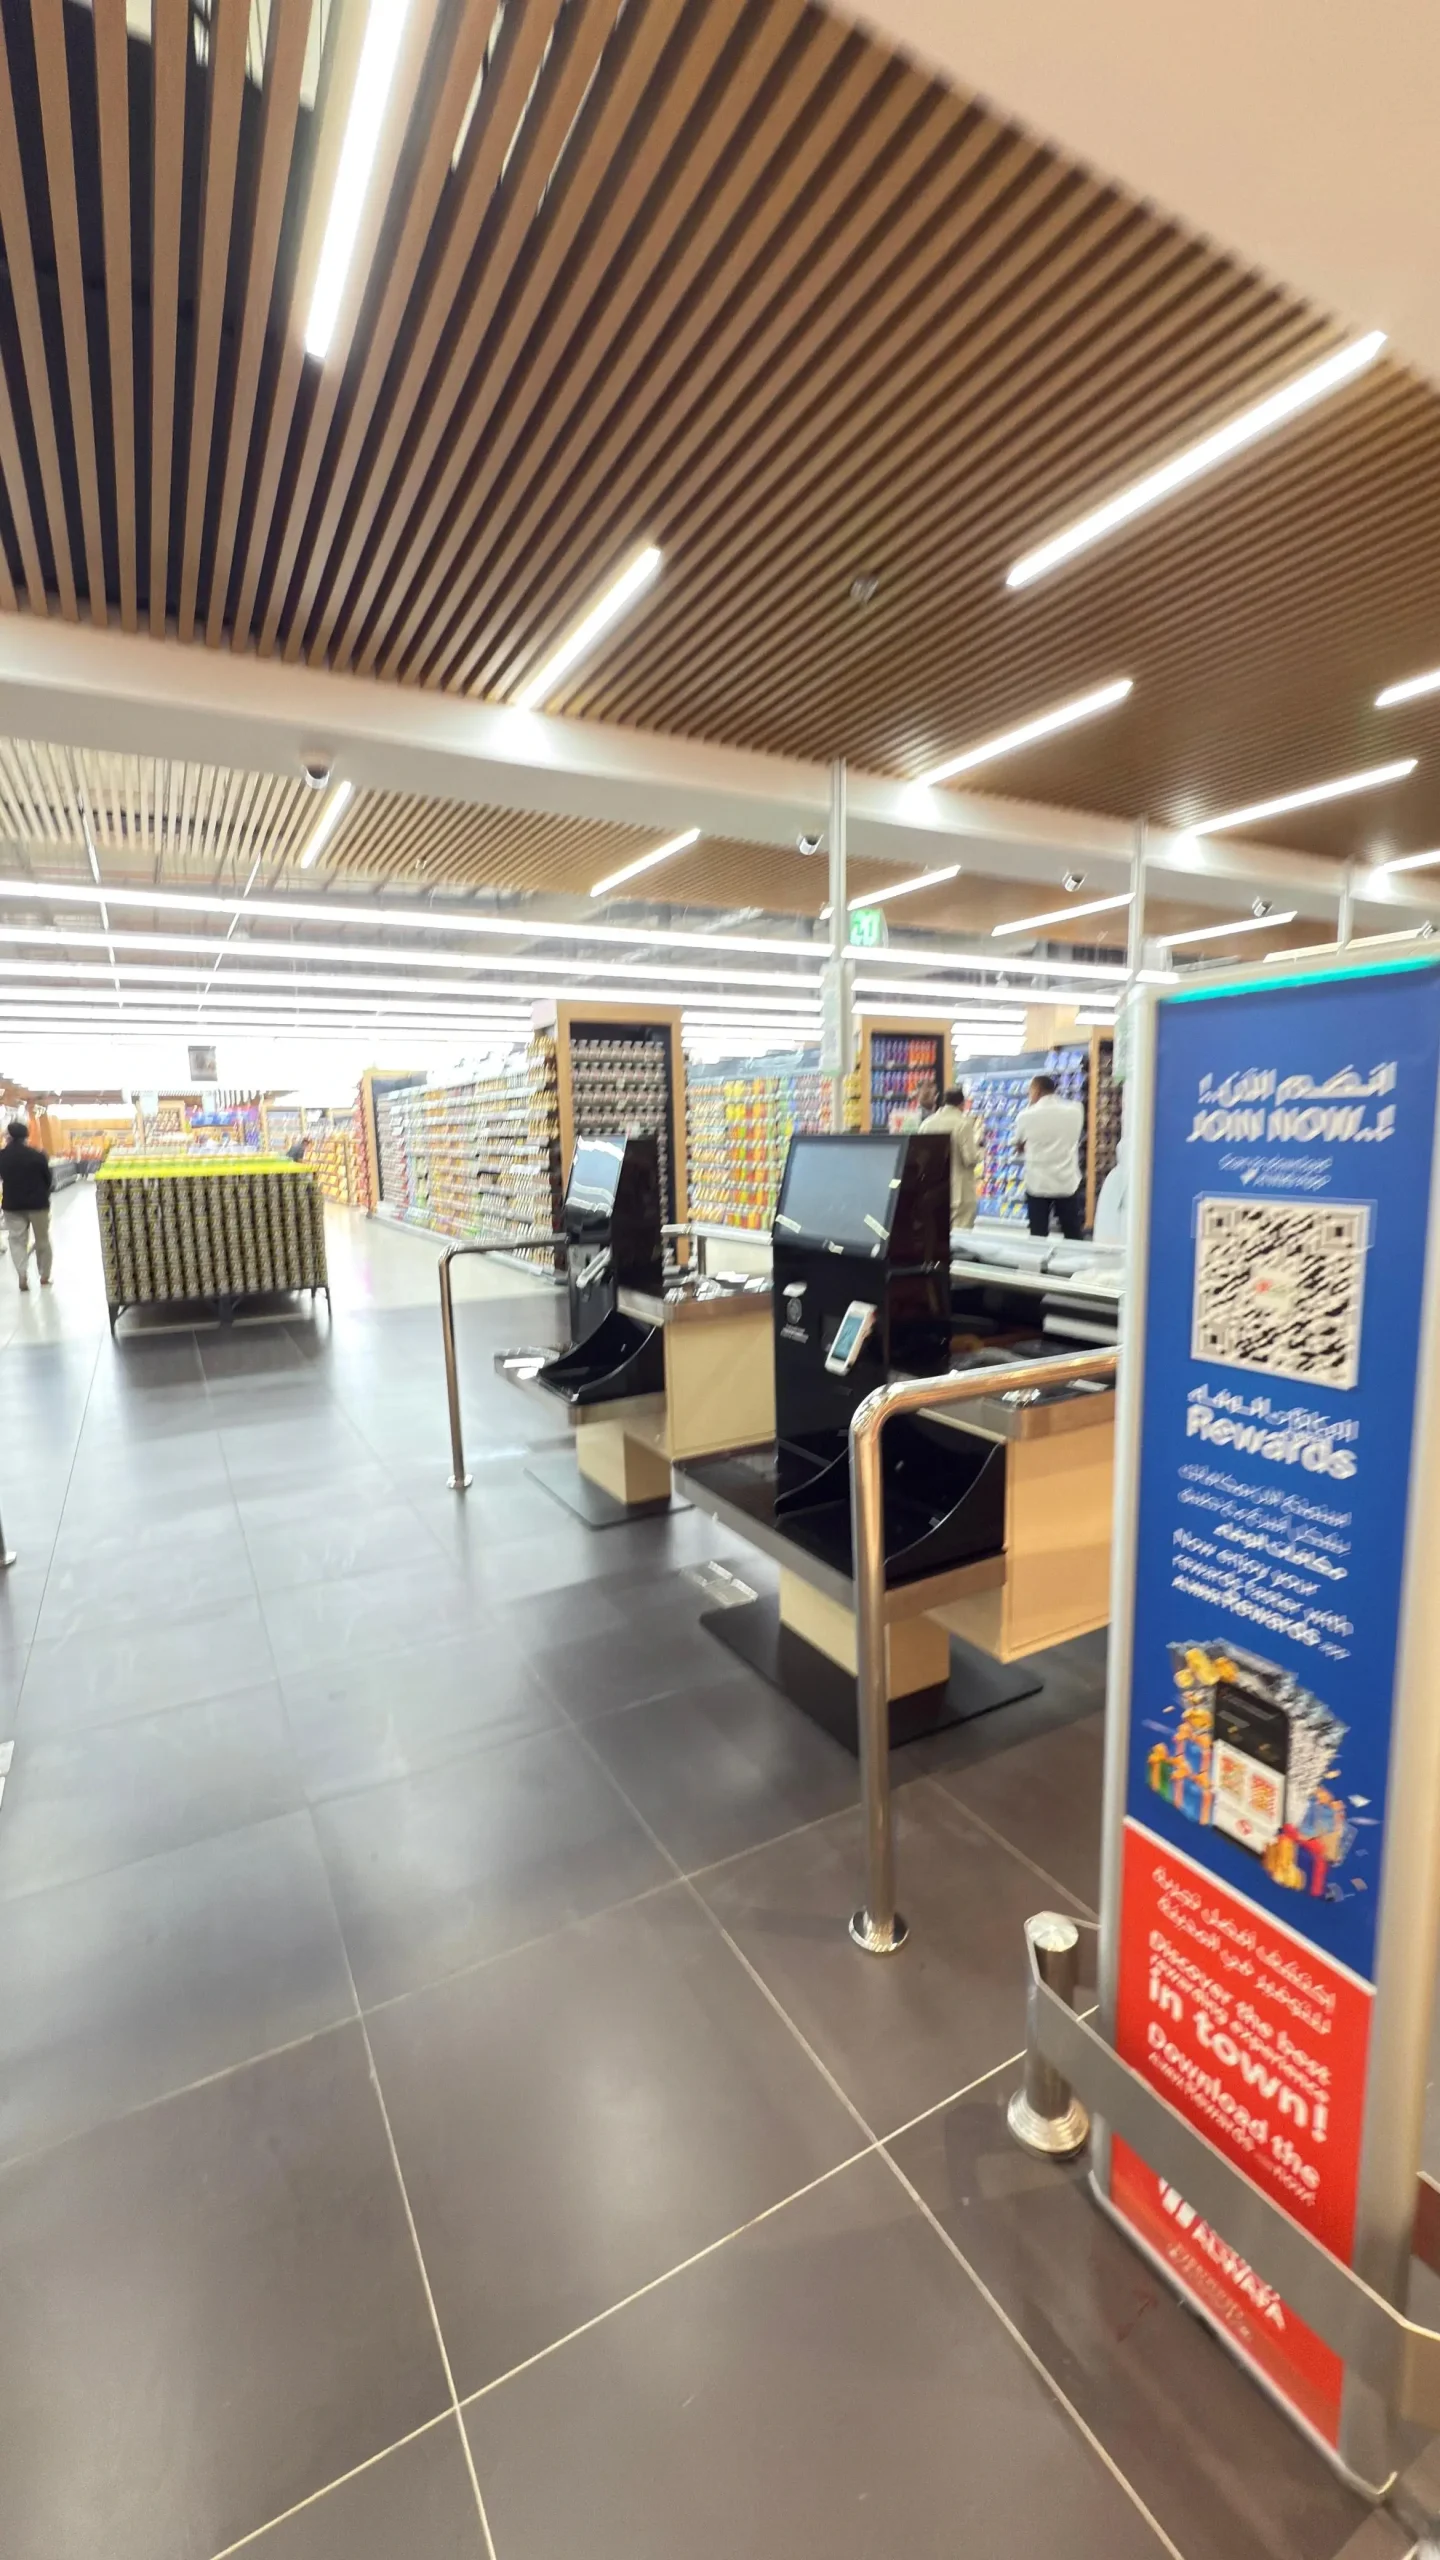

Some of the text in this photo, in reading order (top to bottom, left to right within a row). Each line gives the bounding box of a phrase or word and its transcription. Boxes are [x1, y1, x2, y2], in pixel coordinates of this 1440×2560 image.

[1275, 1061, 1398, 1107] انضم
[1185, 1108, 1265, 1142] JOIN
[1186, 1404, 1357, 1479] Rewards
[1173, 1528, 1321, 1596] Now enjoy your
[1303, 1607, 1354, 1637] with
[1148, 1930, 1331, 2086] Discover the best
[1150, 1967, 1328, 2143] in town!
[1148, 2021, 1320, 2190] Download the
